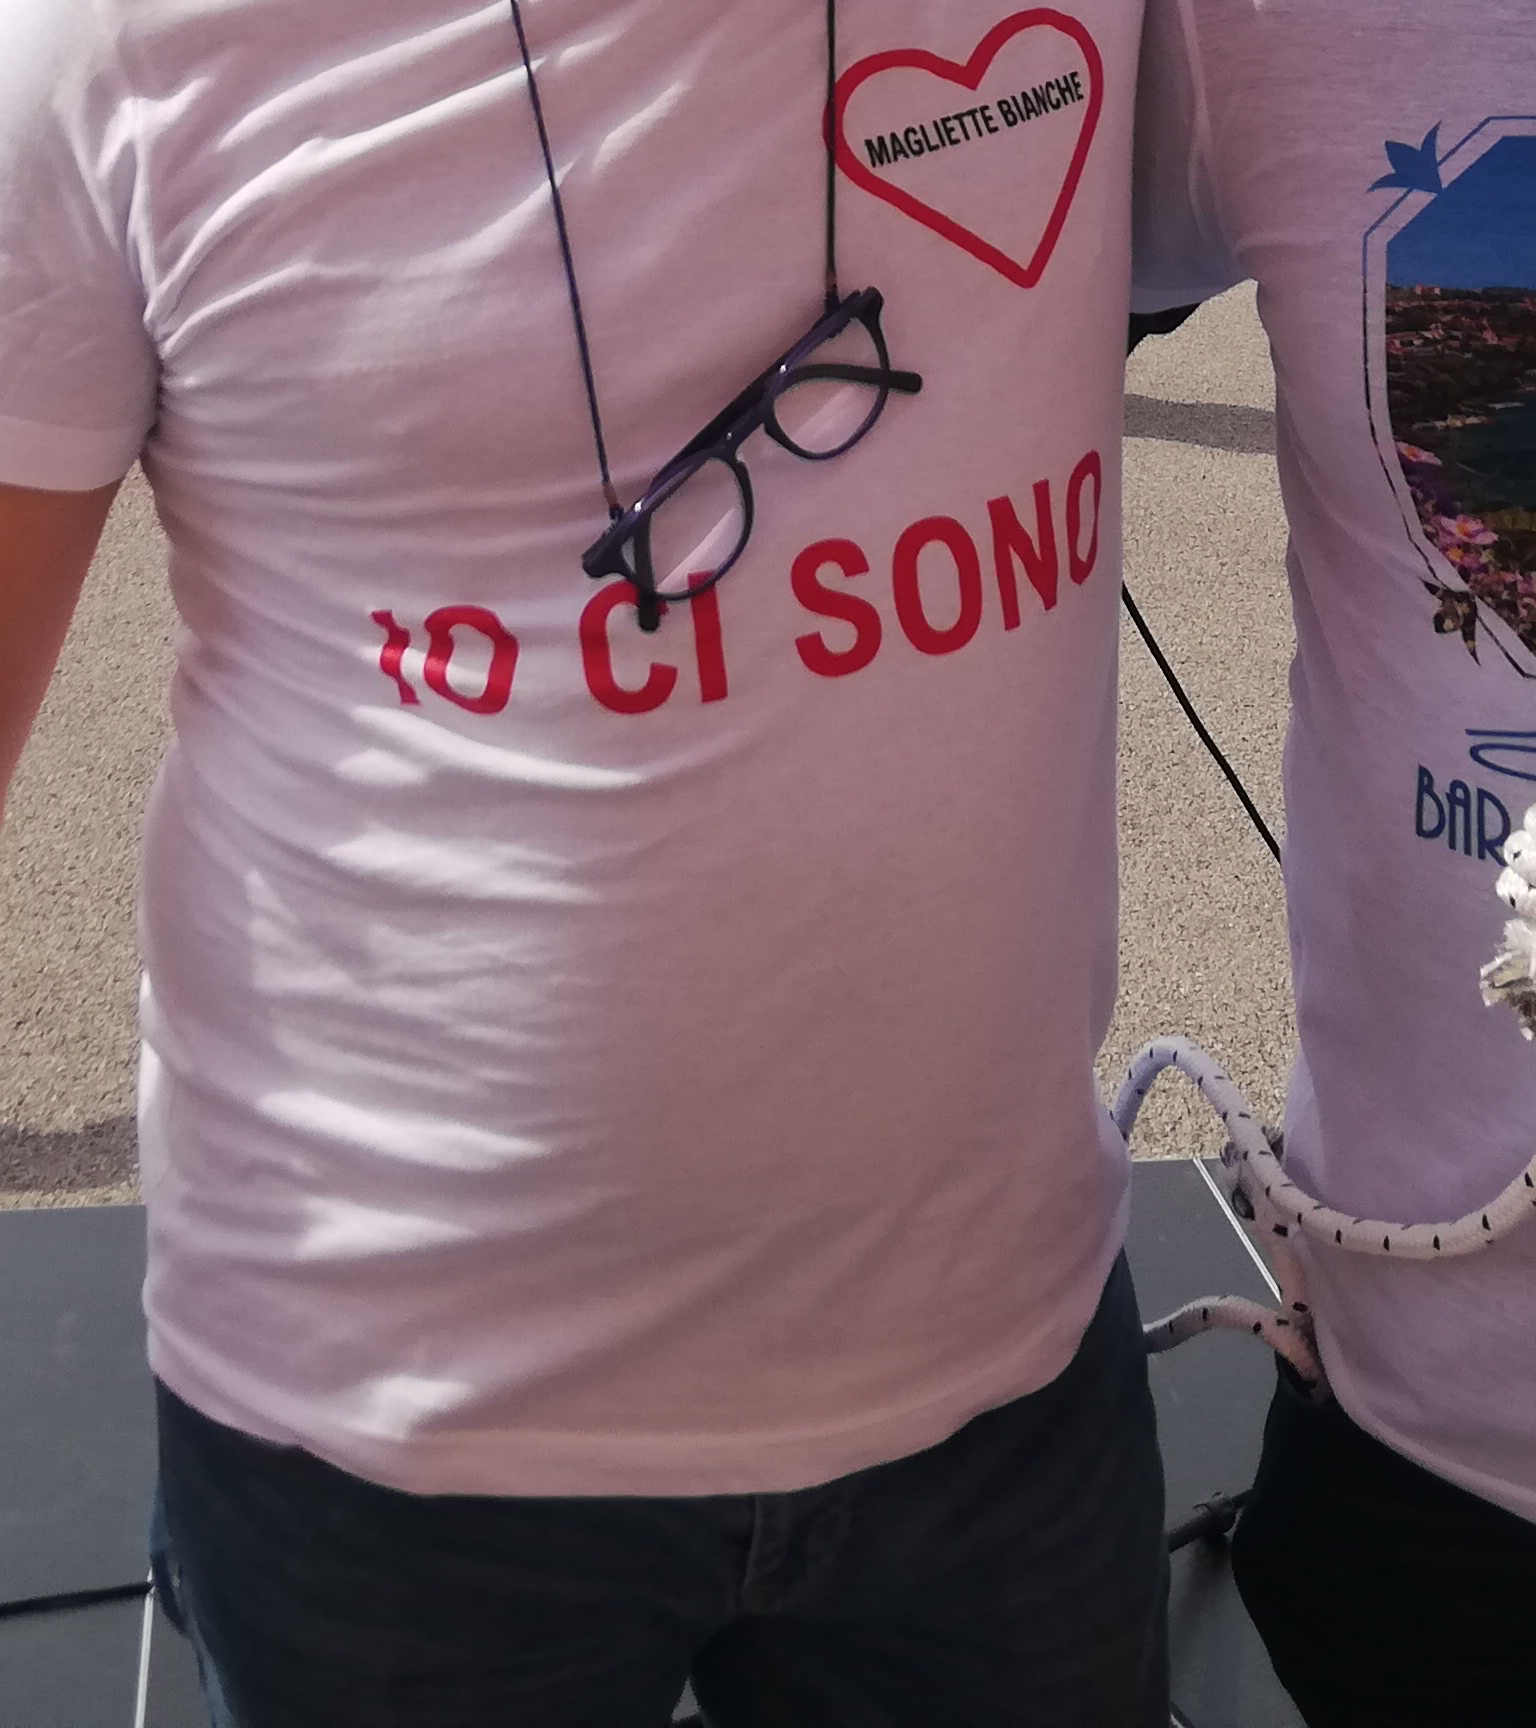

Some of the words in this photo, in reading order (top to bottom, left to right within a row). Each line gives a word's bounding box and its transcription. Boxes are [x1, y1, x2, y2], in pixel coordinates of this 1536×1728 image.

[865, 105, 999, 168] MAGLIETTE
[997, 71, 1084, 128] BIANCHE
[371, 604, 519, 714] IO
[579, 572, 728, 715] CI
[790, 450, 1102, 678] SONO
[1415, 762, 1510, 868] BAR
